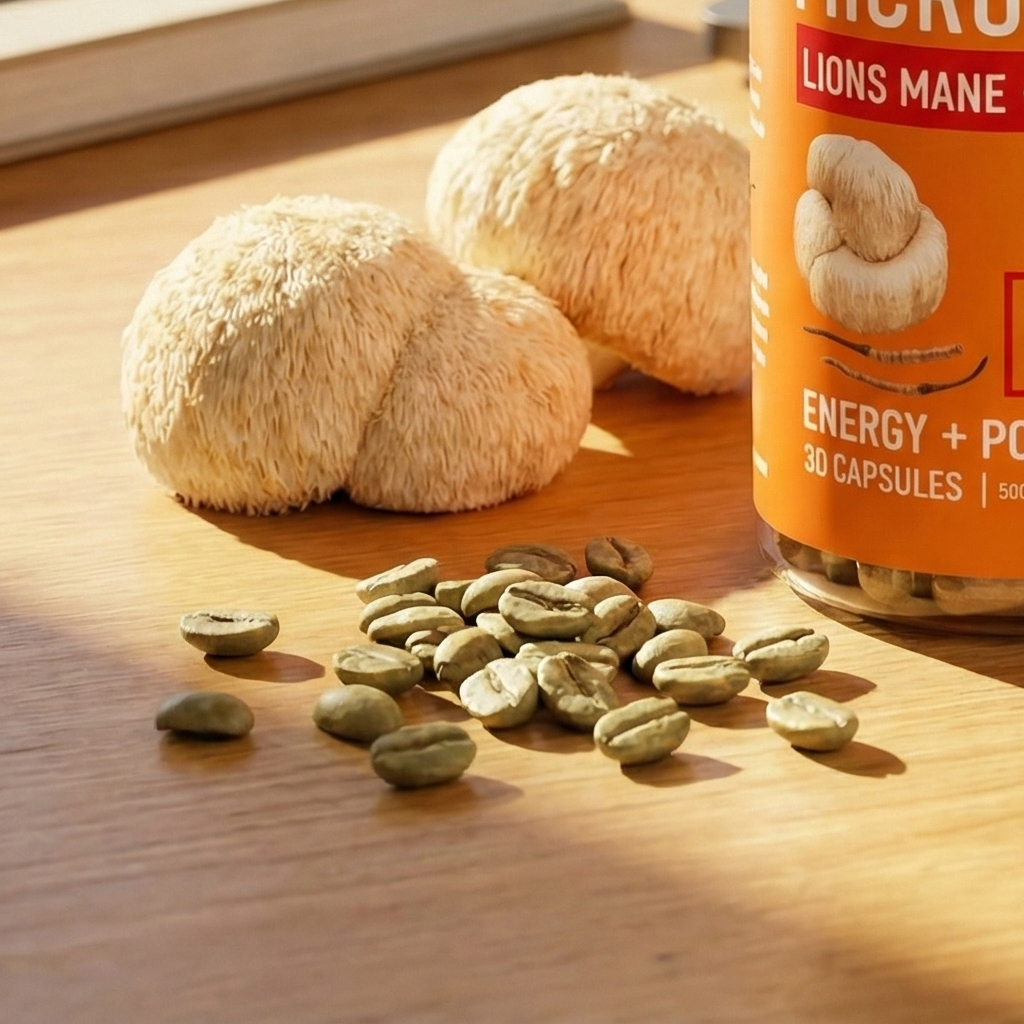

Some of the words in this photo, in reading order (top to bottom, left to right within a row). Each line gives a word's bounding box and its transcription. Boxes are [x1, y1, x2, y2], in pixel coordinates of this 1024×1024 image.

[803, 46, 887, 104] LIONS
[900, 68, 1006, 114] MANE
[803, 388, 928, 453] ENERGY
[942, 423, 967, 450] +
[833, 452, 963, 501] CAPSULES
